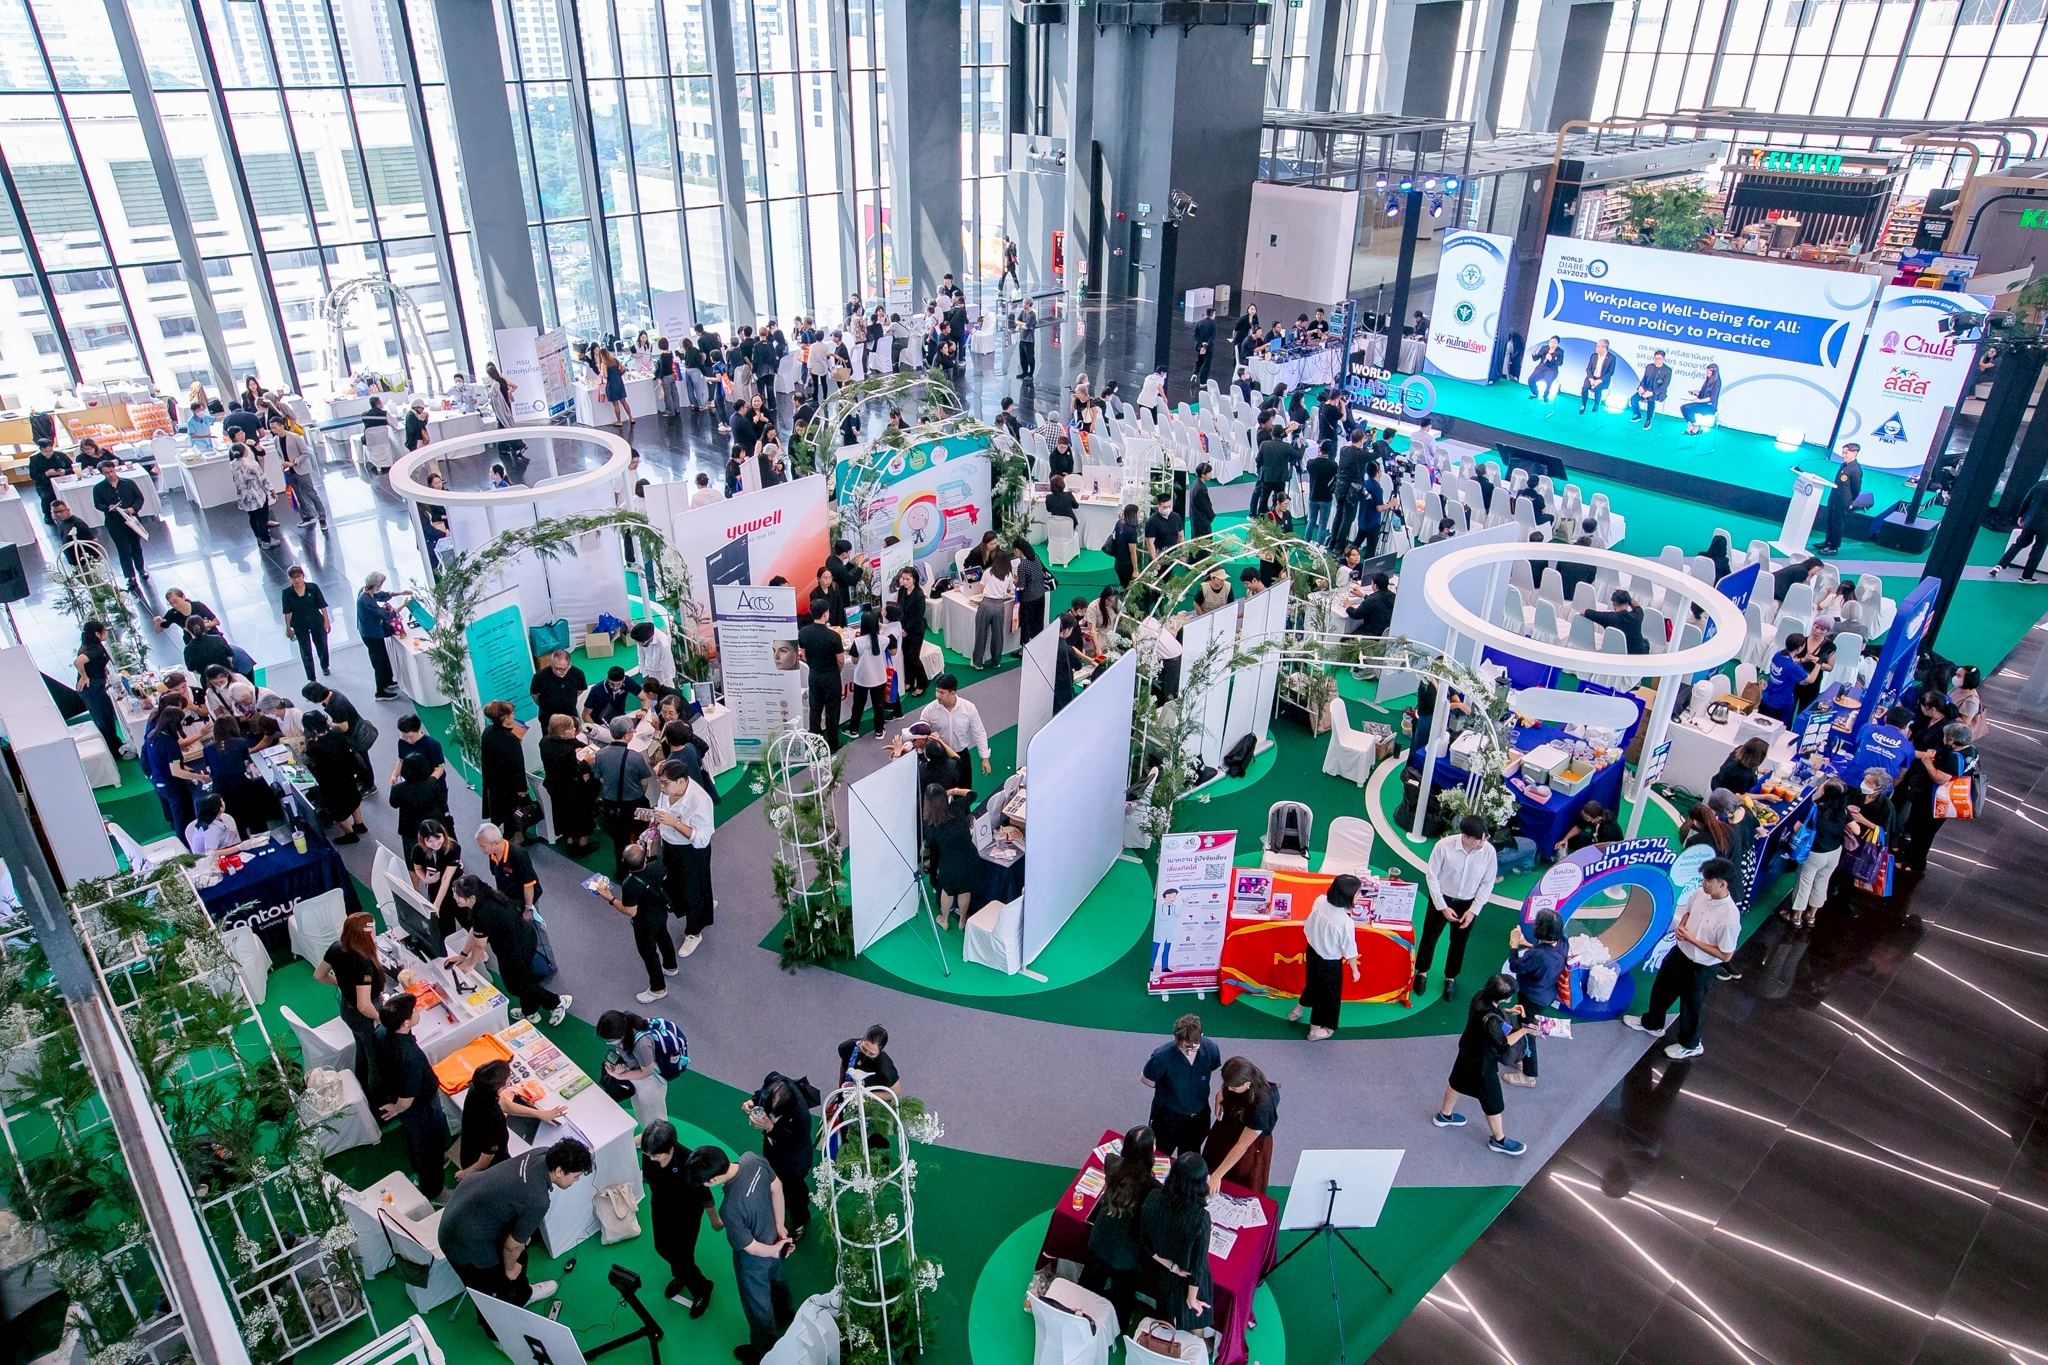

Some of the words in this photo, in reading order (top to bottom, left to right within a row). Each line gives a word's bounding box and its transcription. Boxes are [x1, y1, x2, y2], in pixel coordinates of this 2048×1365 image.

[1558, 261, 1601, 273] DIABETES
[1560, 255, 1583, 263] WORLD
[1557, 268, 1588, 278] DAY2025
[1584, 290, 1657, 312] Workplace
[1661, 302, 1743, 327] Well-being
[1747, 315, 1771, 329] for
[1774, 320, 1801, 334] All:
[1911, 298, 1940, 306] Diabetes
[1940, 302, 1953, 310] and
[1599, 310, 1635, 326] From
[1638, 316, 1684, 336] Policy
[1687, 326, 1703, 337] to
[1706, 328, 1771, 348] Practice
[1904, 335, 1956, 357] Chula
[1352, 362, 1391, 381] WORLD
[1350, 375, 1424, 405] DIABETES
[1884, 376, 1931, 395] สสส
[1348, 390, 1403, 415] DAY2025
[727, 509, 781, 540] yuwell
[1872, 732, 1902, 747] equal
[1605, 838, 1669, 856] เบาหวาน
[1585, 848, 1677, 876] แต่ภาระหนัก
[225, 896, 301, 929] ontour
